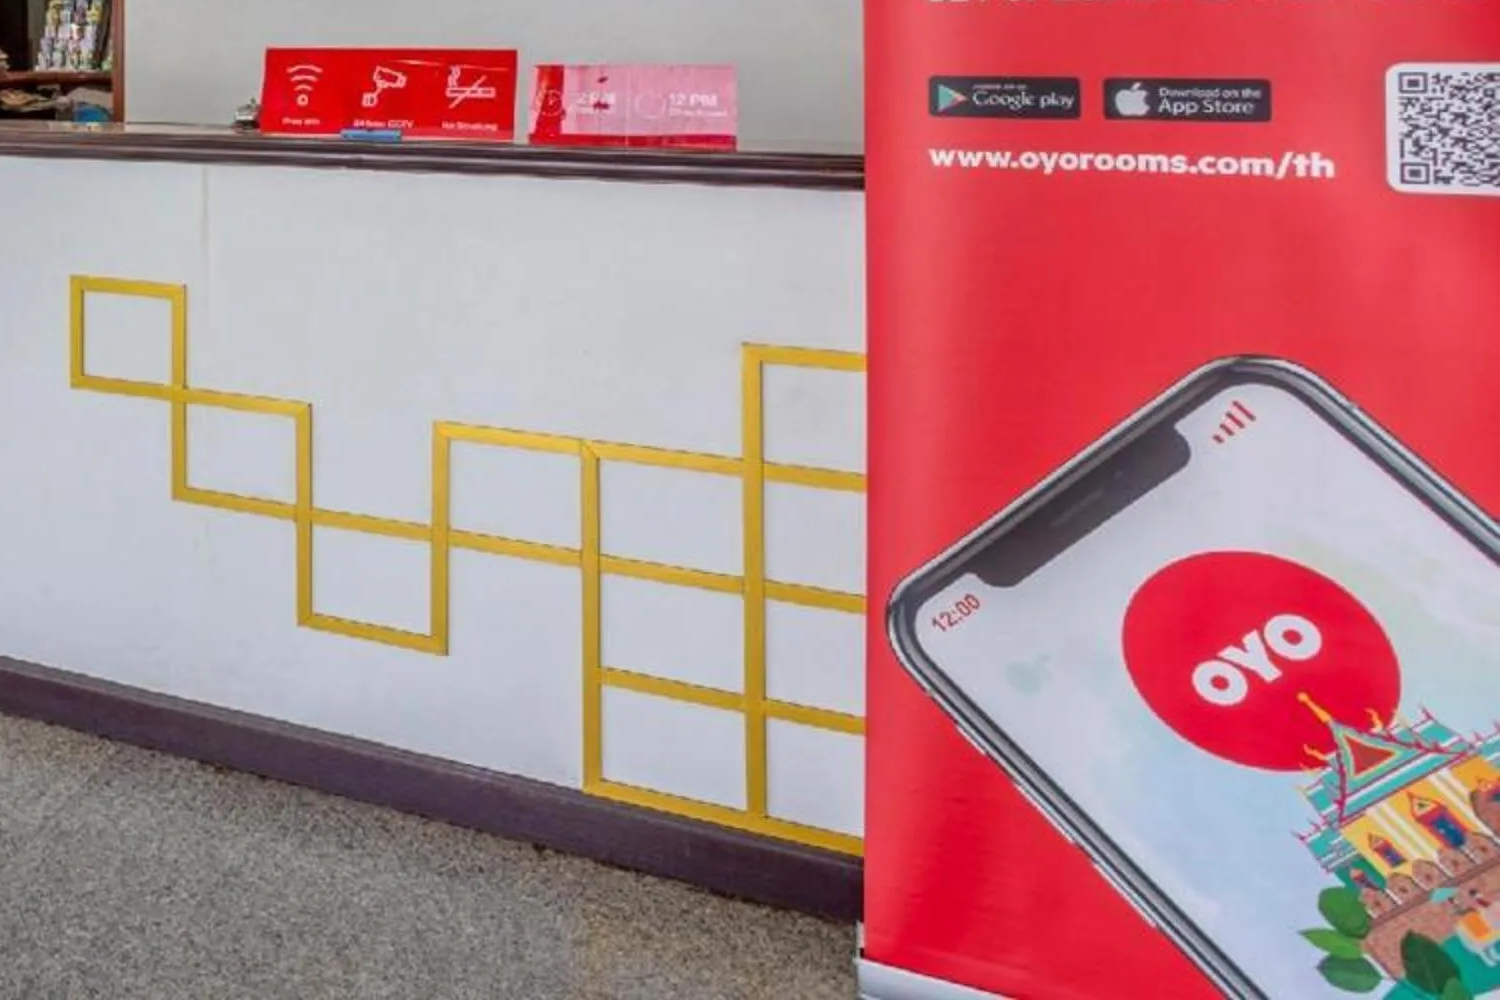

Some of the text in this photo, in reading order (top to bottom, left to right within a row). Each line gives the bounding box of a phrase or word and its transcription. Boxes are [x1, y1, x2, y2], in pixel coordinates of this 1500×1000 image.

[971, 90, 1075, 110] Google play
[1157, 98, 1254, 116] App Store
[927, 147, 1336, 181] www.oyorooms.com/th
[931, 593, 982, 634] 12:00
[1191, 613, 1323, 707] OYO
